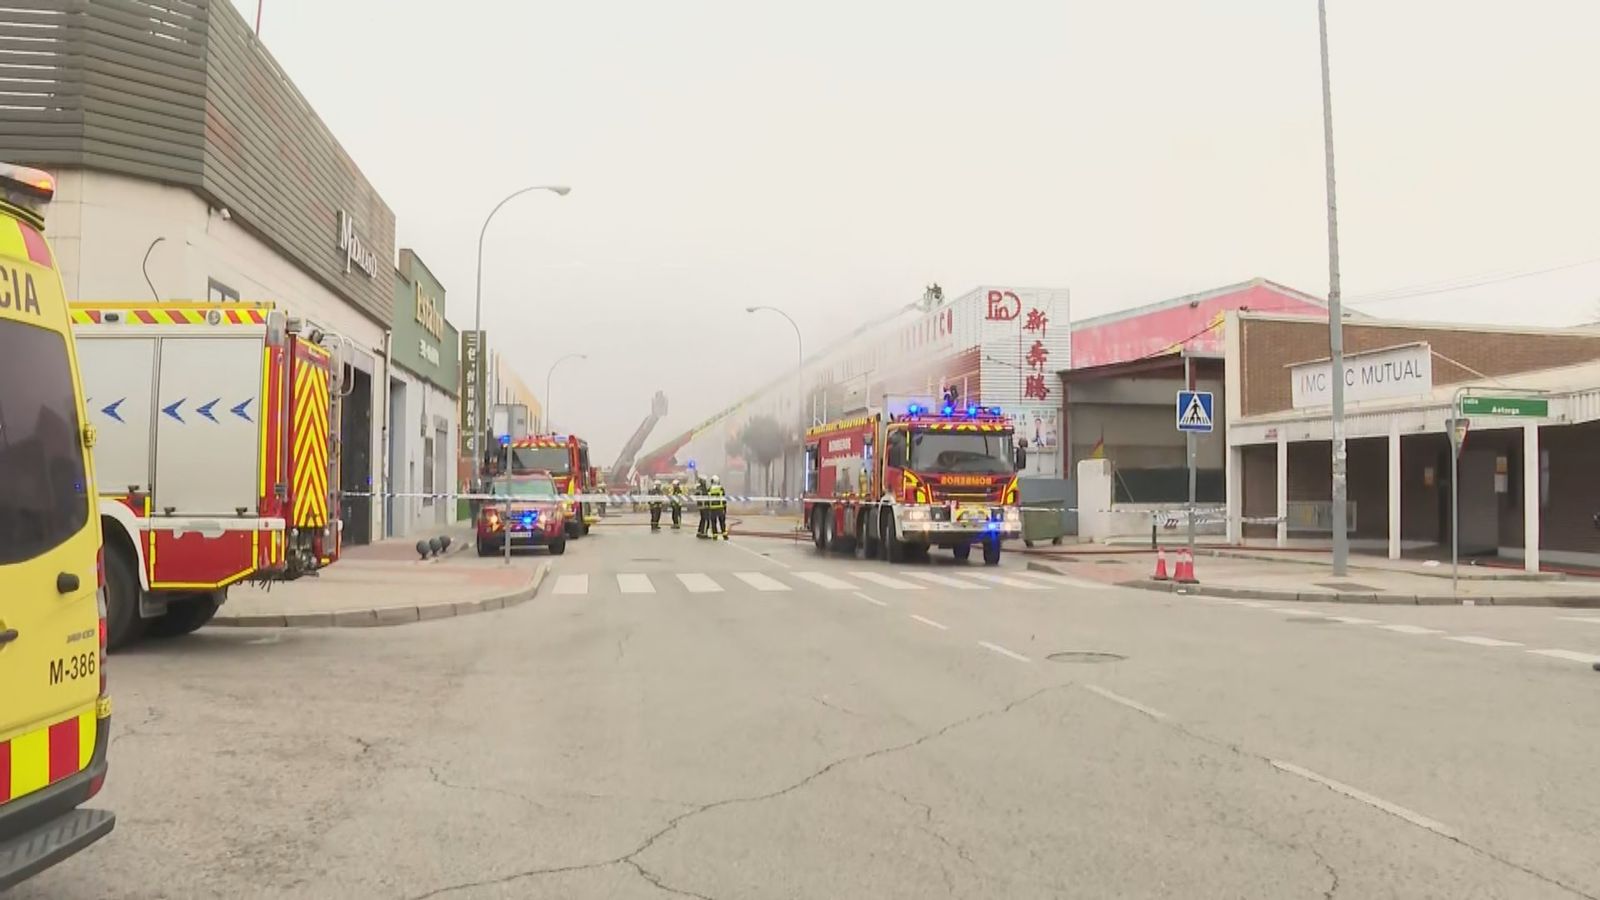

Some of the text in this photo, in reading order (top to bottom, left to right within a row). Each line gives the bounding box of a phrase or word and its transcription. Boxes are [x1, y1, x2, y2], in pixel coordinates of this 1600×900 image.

[1361, 359, 1422, 385] MUTUAL
[1491, 406, 1520, 415] Astorga
[49, 651, 96, 686] M-386
